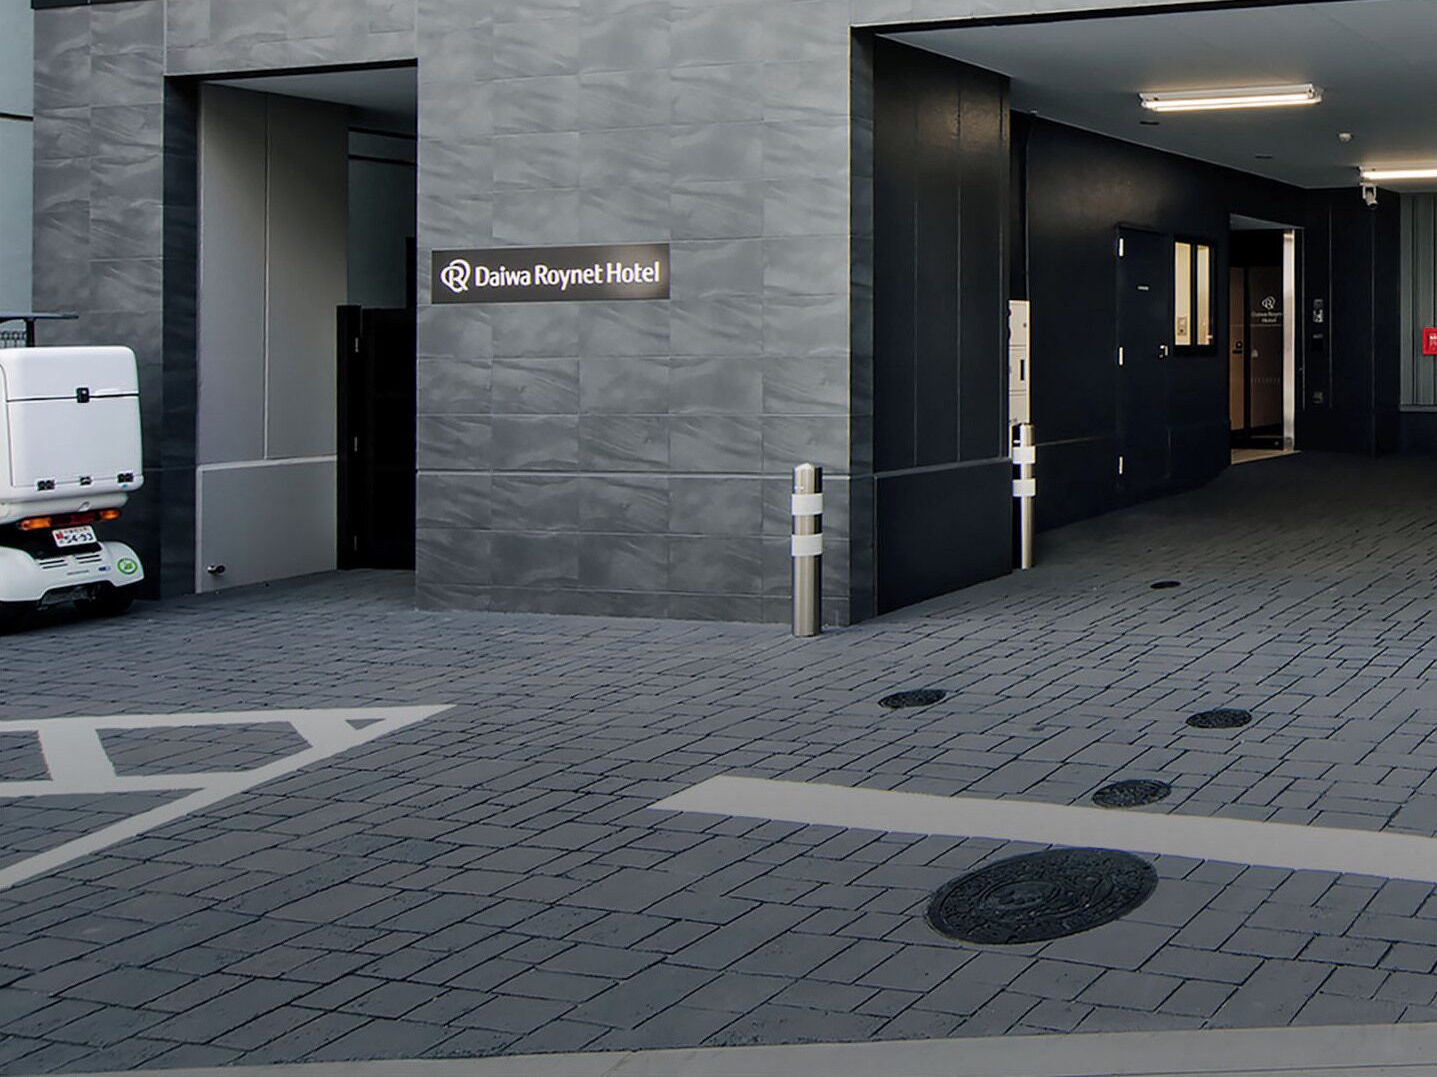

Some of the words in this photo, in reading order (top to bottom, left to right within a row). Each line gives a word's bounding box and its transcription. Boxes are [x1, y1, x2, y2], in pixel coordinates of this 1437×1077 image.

[474, 265, 532, 287] Daiwa
[534, 263, 604, 291] Roynet
[606, 261, 660, 284] Hotel
